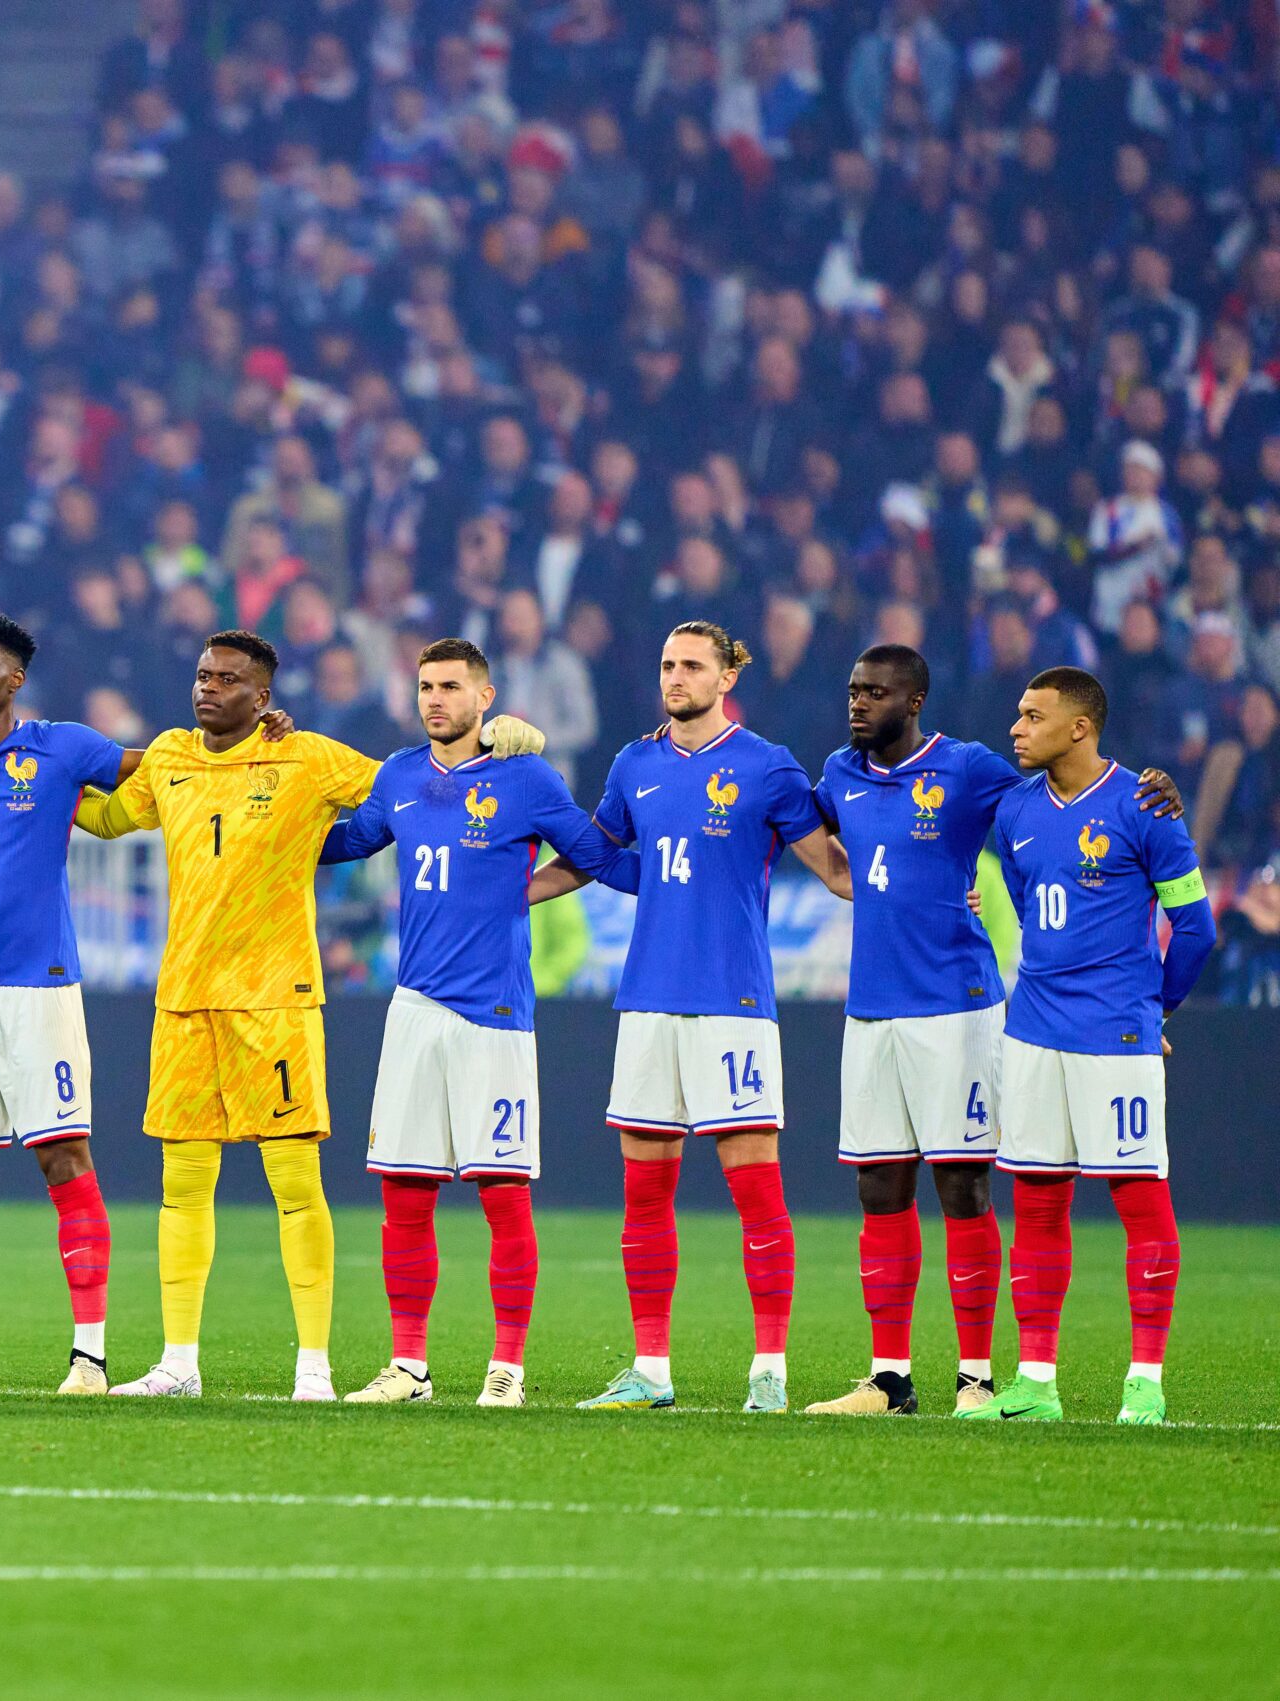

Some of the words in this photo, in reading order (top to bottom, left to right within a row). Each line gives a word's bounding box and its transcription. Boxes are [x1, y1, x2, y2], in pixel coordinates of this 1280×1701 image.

[210, 814, 222, 858] 1
[414, 844, 450, 891] 21
[656, 836, 692, 884] 14
[867, 845, 889, 892] 4
[1035, 883, 1067, 931] 10
[55, 1061, 75, 1104] 8
[273, 1059, 292, 1103] 1
[721, 1050, 765, 1096] 14
[492, 1098, 526, 1143] 21
[966, 1082, 988, 1126] 4
[1110, 1096, 1149, 1142] 10
